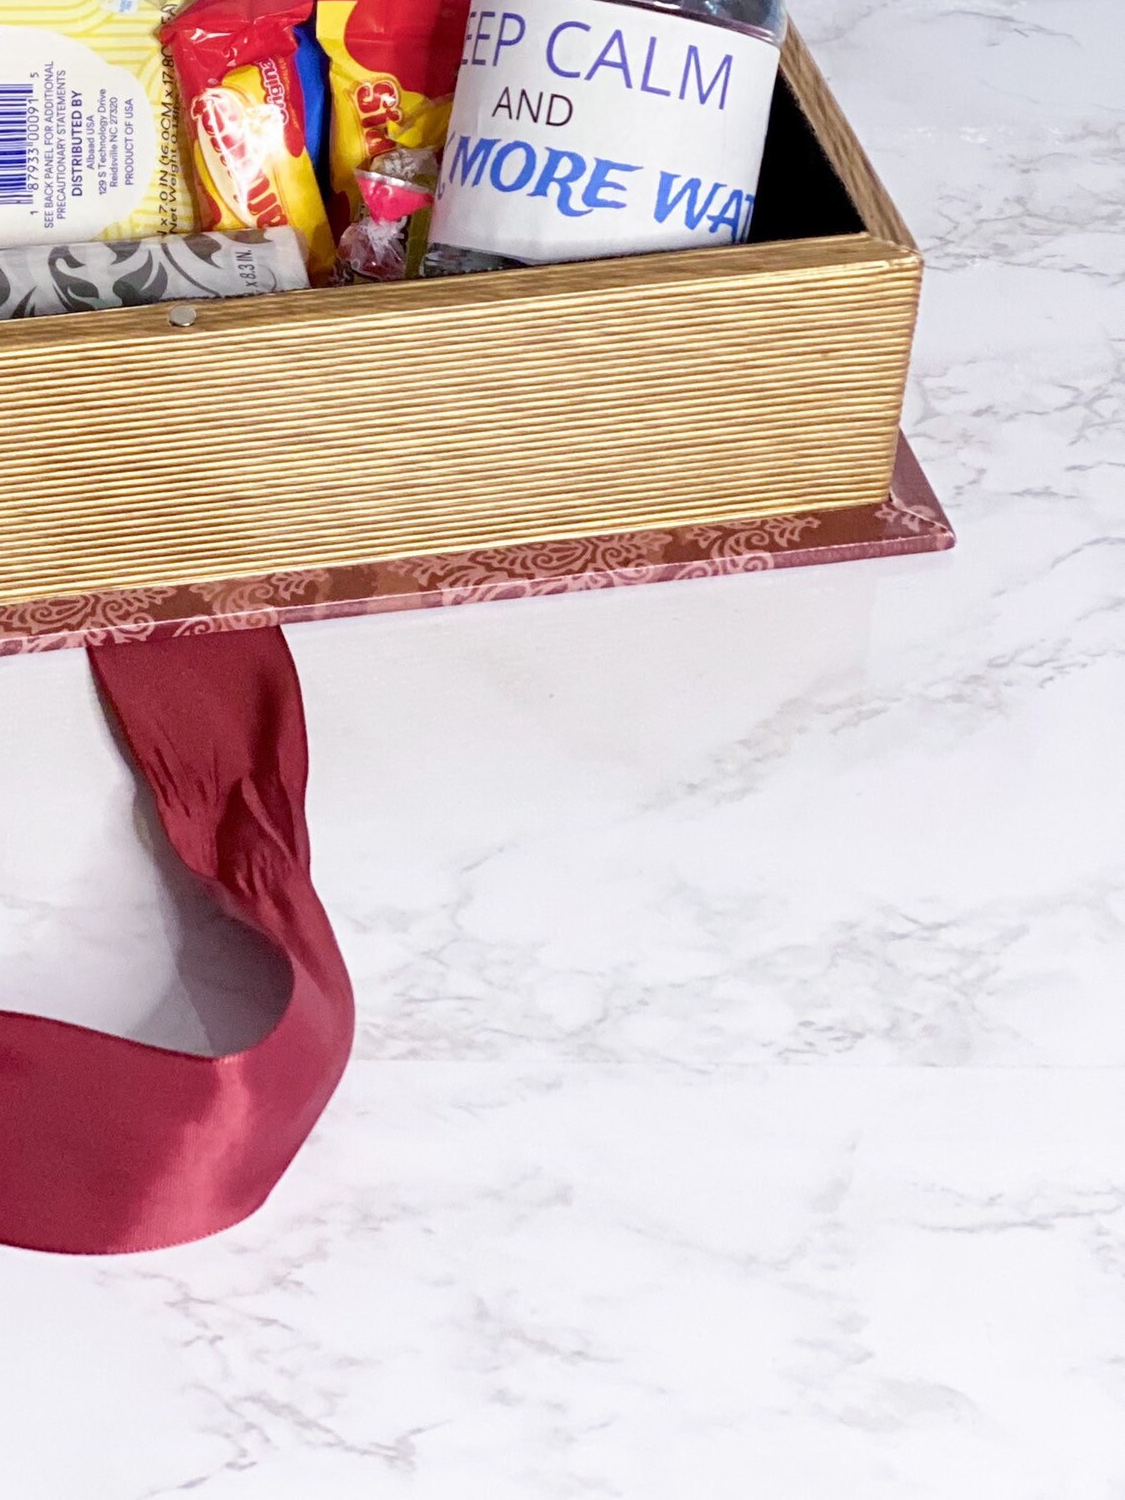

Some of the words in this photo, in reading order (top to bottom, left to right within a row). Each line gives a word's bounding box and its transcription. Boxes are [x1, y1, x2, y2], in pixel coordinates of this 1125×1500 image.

[546, 18, 734, 110] CALM
[43, 60, 54, 122] ADDITIONAL
[55, 69, 67, 134] STATEMENTS
[71, 90, 82, 106] BY
[97, 88, 106, 112] Drive
[26, 97, 39, 141] 00091
[109, 96, 118, 124] 27320
[124, 98, 133, 118] USA
[492, 86, 573, 128] AND
[43, 125, 53, 145] FOR
[85, 114, 94, 134] USA
[109, 126, 117, 142] NC
[124, 121, 133, 134] OF
[70, 110, 84, 196] DISTRIBUTED
[86, 137, 95, 169] Albaad
[98, 115, 108, 168] Technology
[26, 147, 39, 190] 87933
[43, 148, 53, 178] PANEL
[109, 144, 118, 187] Reidsville
[124, 137, 134, 185] PRODUCT
[55, 137, 67, 219] PRECAUTIONARY
[98, 180, 106, 194] 129
[158, 169, 168, 186] IN
[168, 149, 179, 202] Weight
[449, 136, 645, 218] MORE
[43, 180, 54, 207] BACK
[158, 190, 168, 214] 7.0
[44, 210, 53, 228] SEE
[168, 207, 177, 234] Net
[234, 250, 253, 260] IN.
[237, 264, 256, 279] 8.3
